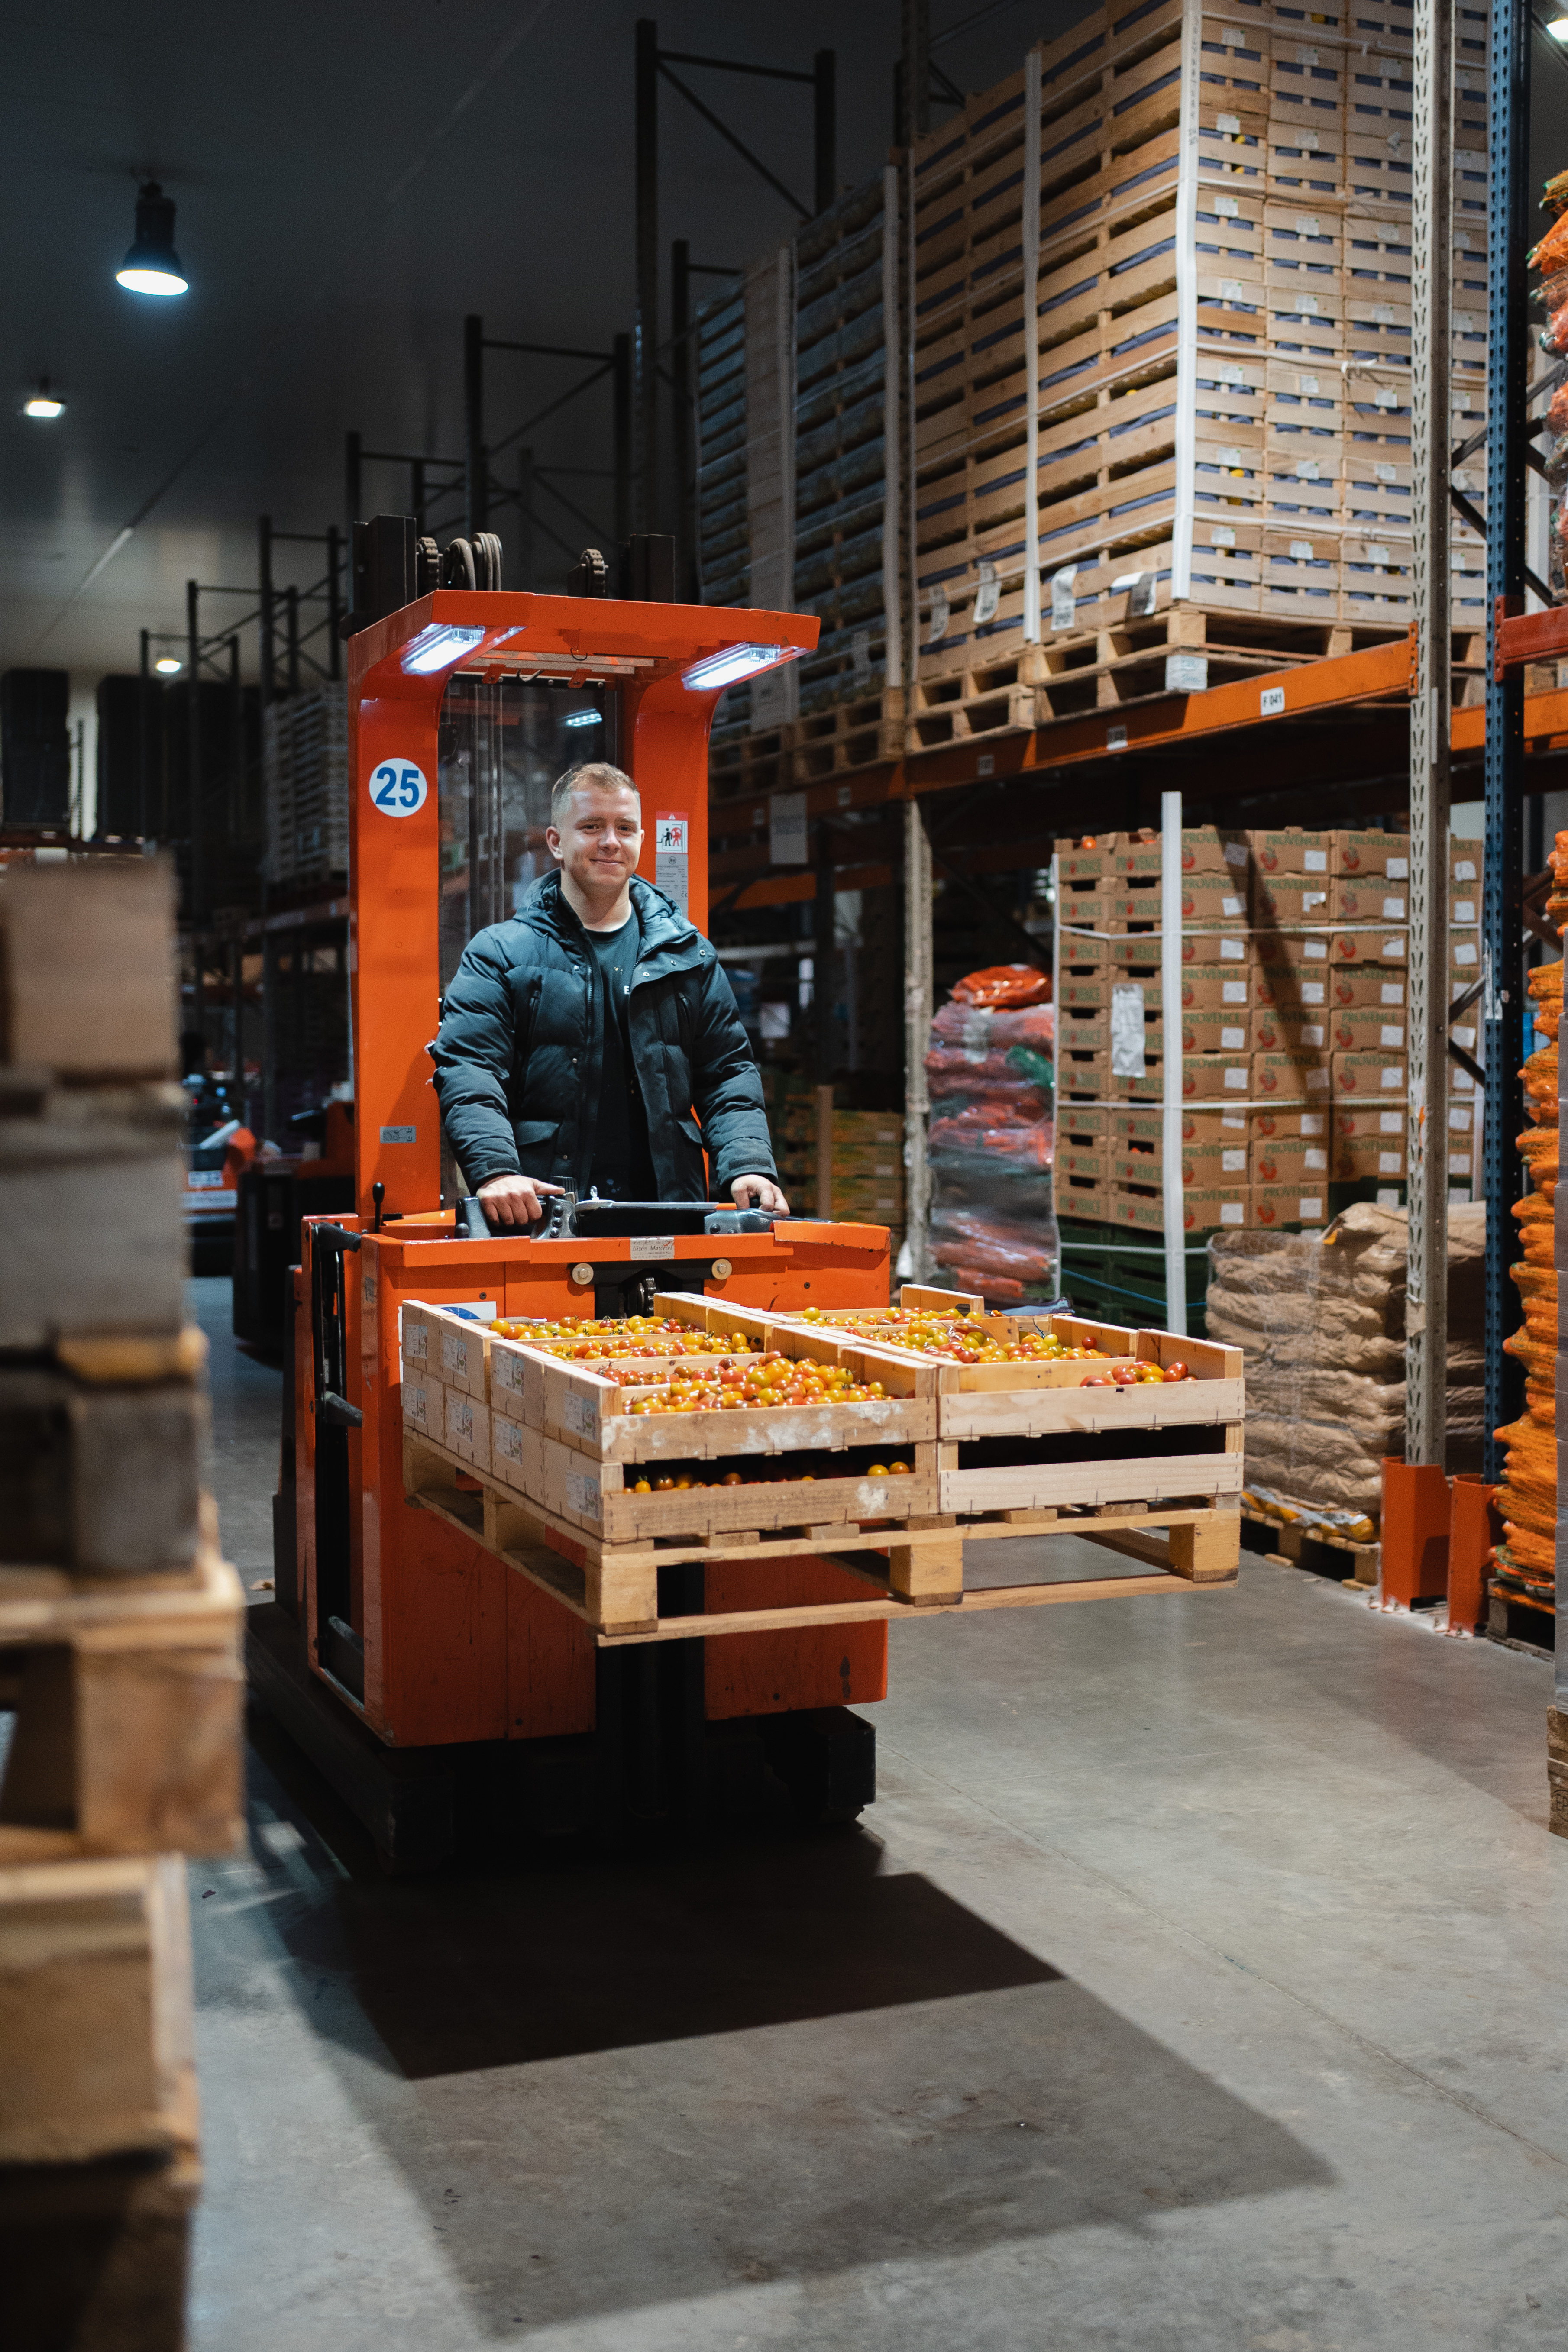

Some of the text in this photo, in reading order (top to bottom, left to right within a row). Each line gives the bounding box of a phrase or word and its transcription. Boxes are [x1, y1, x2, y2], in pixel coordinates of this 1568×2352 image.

[375, 767, 419, 808] 25
[1266, 834, 1320, 846] PROVENCE
[1348, 834, 1402, 847] PROVENCE
[1264, 878, 1319, 890] PROVENCE
[1182, 968, 1238, 980] PROVENCE
[1183, 1012, 1239, 1024] PROVENCE
[1342, 1011, 1396, 1023] PROVENCE
[1183, 1057, 1239, 1068] PROVENCE
[1184, 1190, 1238, 1201] PROVENCE
[1264, 1186, 1317, 1197] PROVENCE
